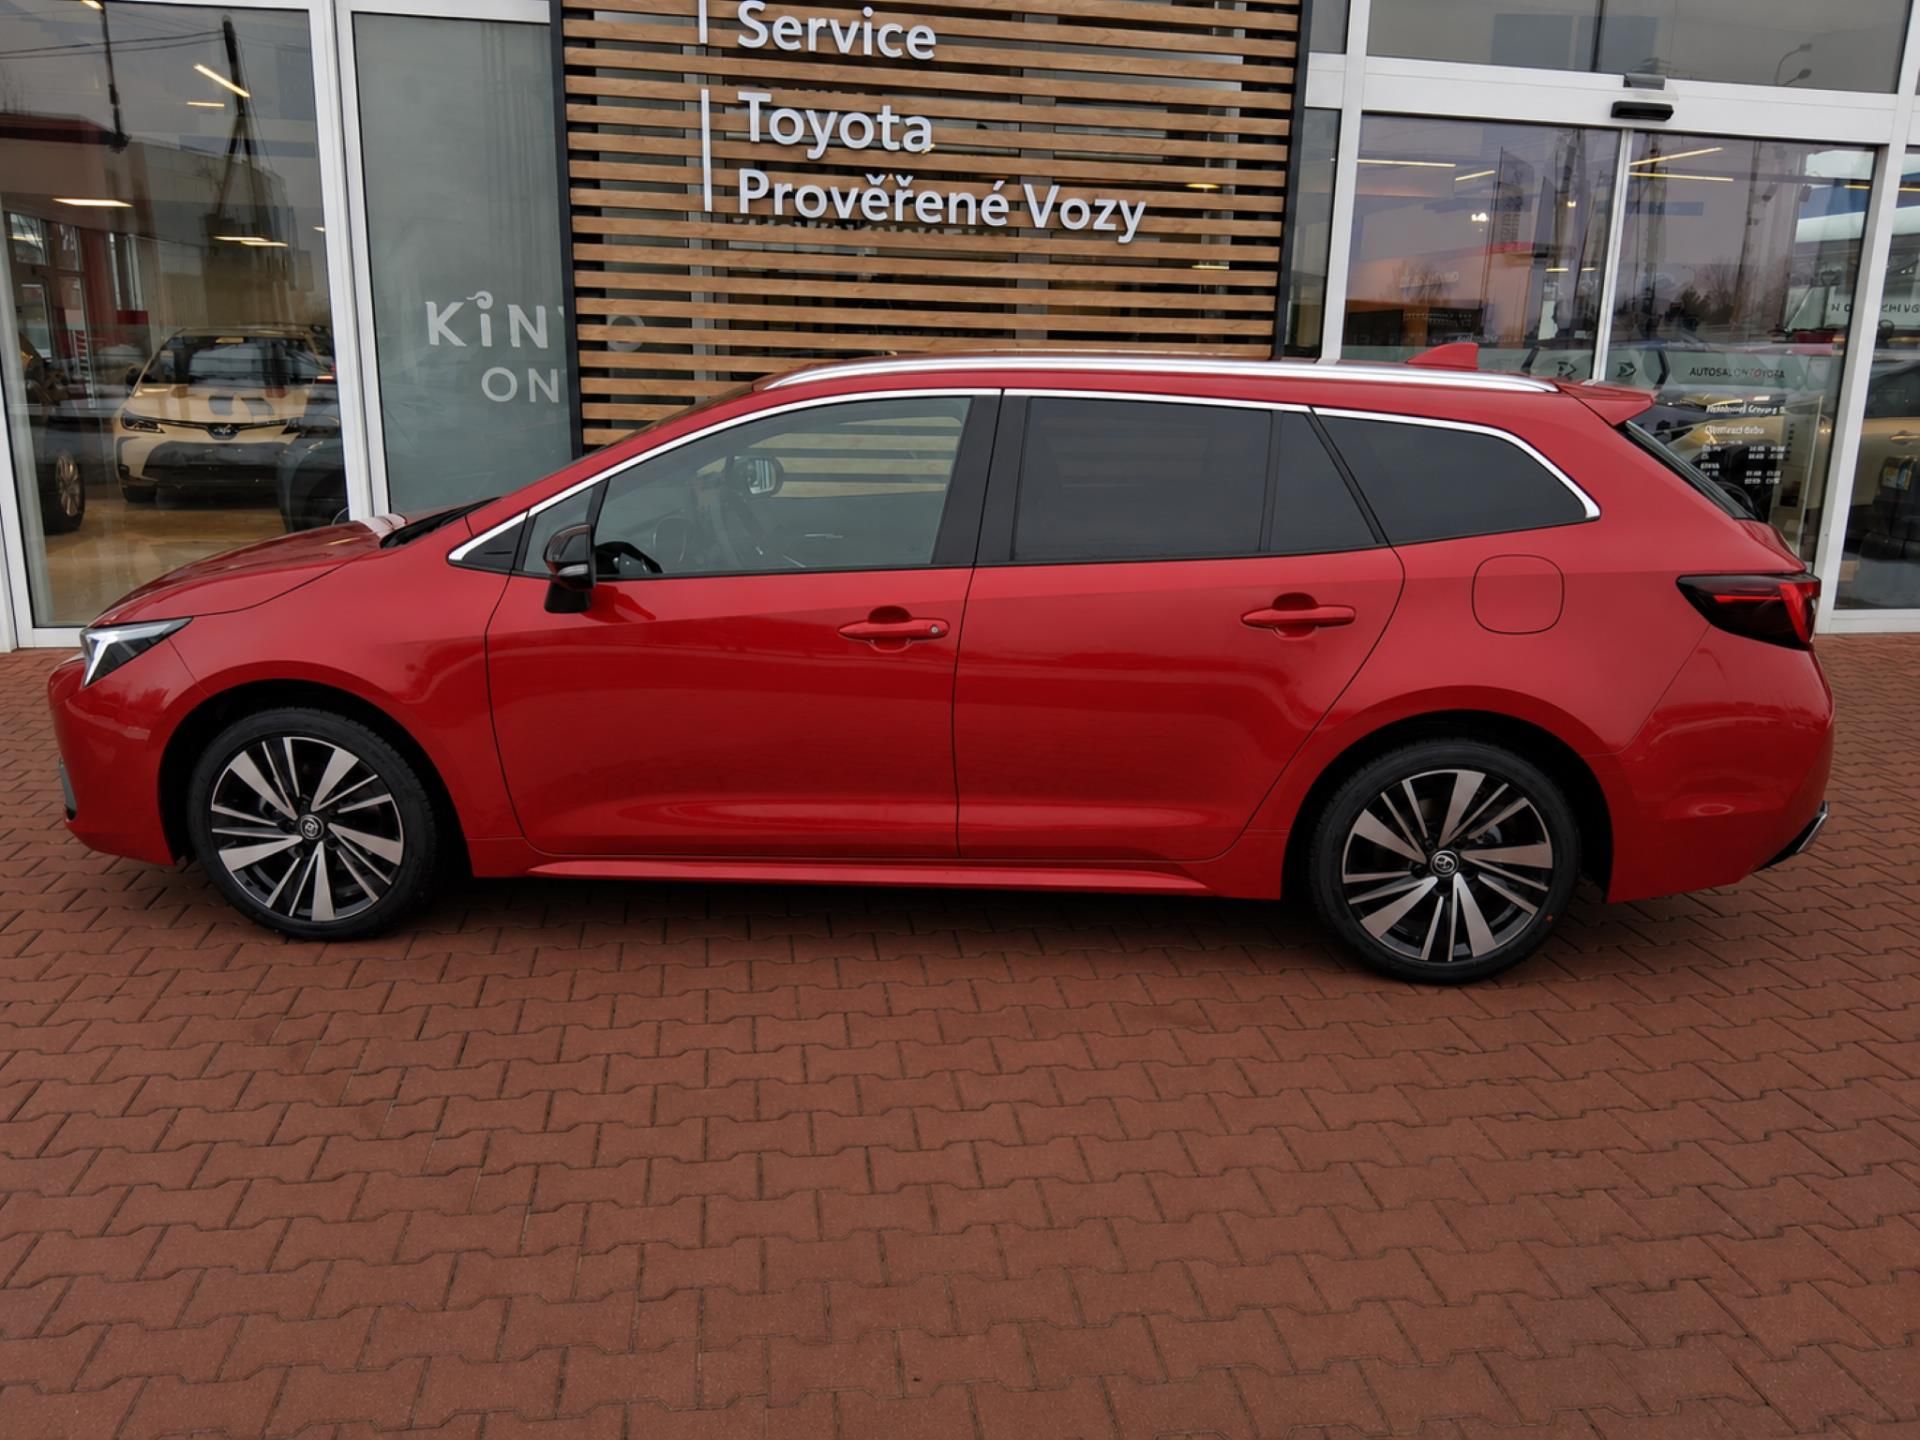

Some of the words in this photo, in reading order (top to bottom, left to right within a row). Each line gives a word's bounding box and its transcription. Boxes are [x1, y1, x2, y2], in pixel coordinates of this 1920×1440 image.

[737, 0, 937, 60] Service
[737, 91, 932, 159] Toyota
[738, 169, 1009, 226] Prověřené
[1023, 183, 1147, 243] Vozy
[481, 367, 560, 402] ON
